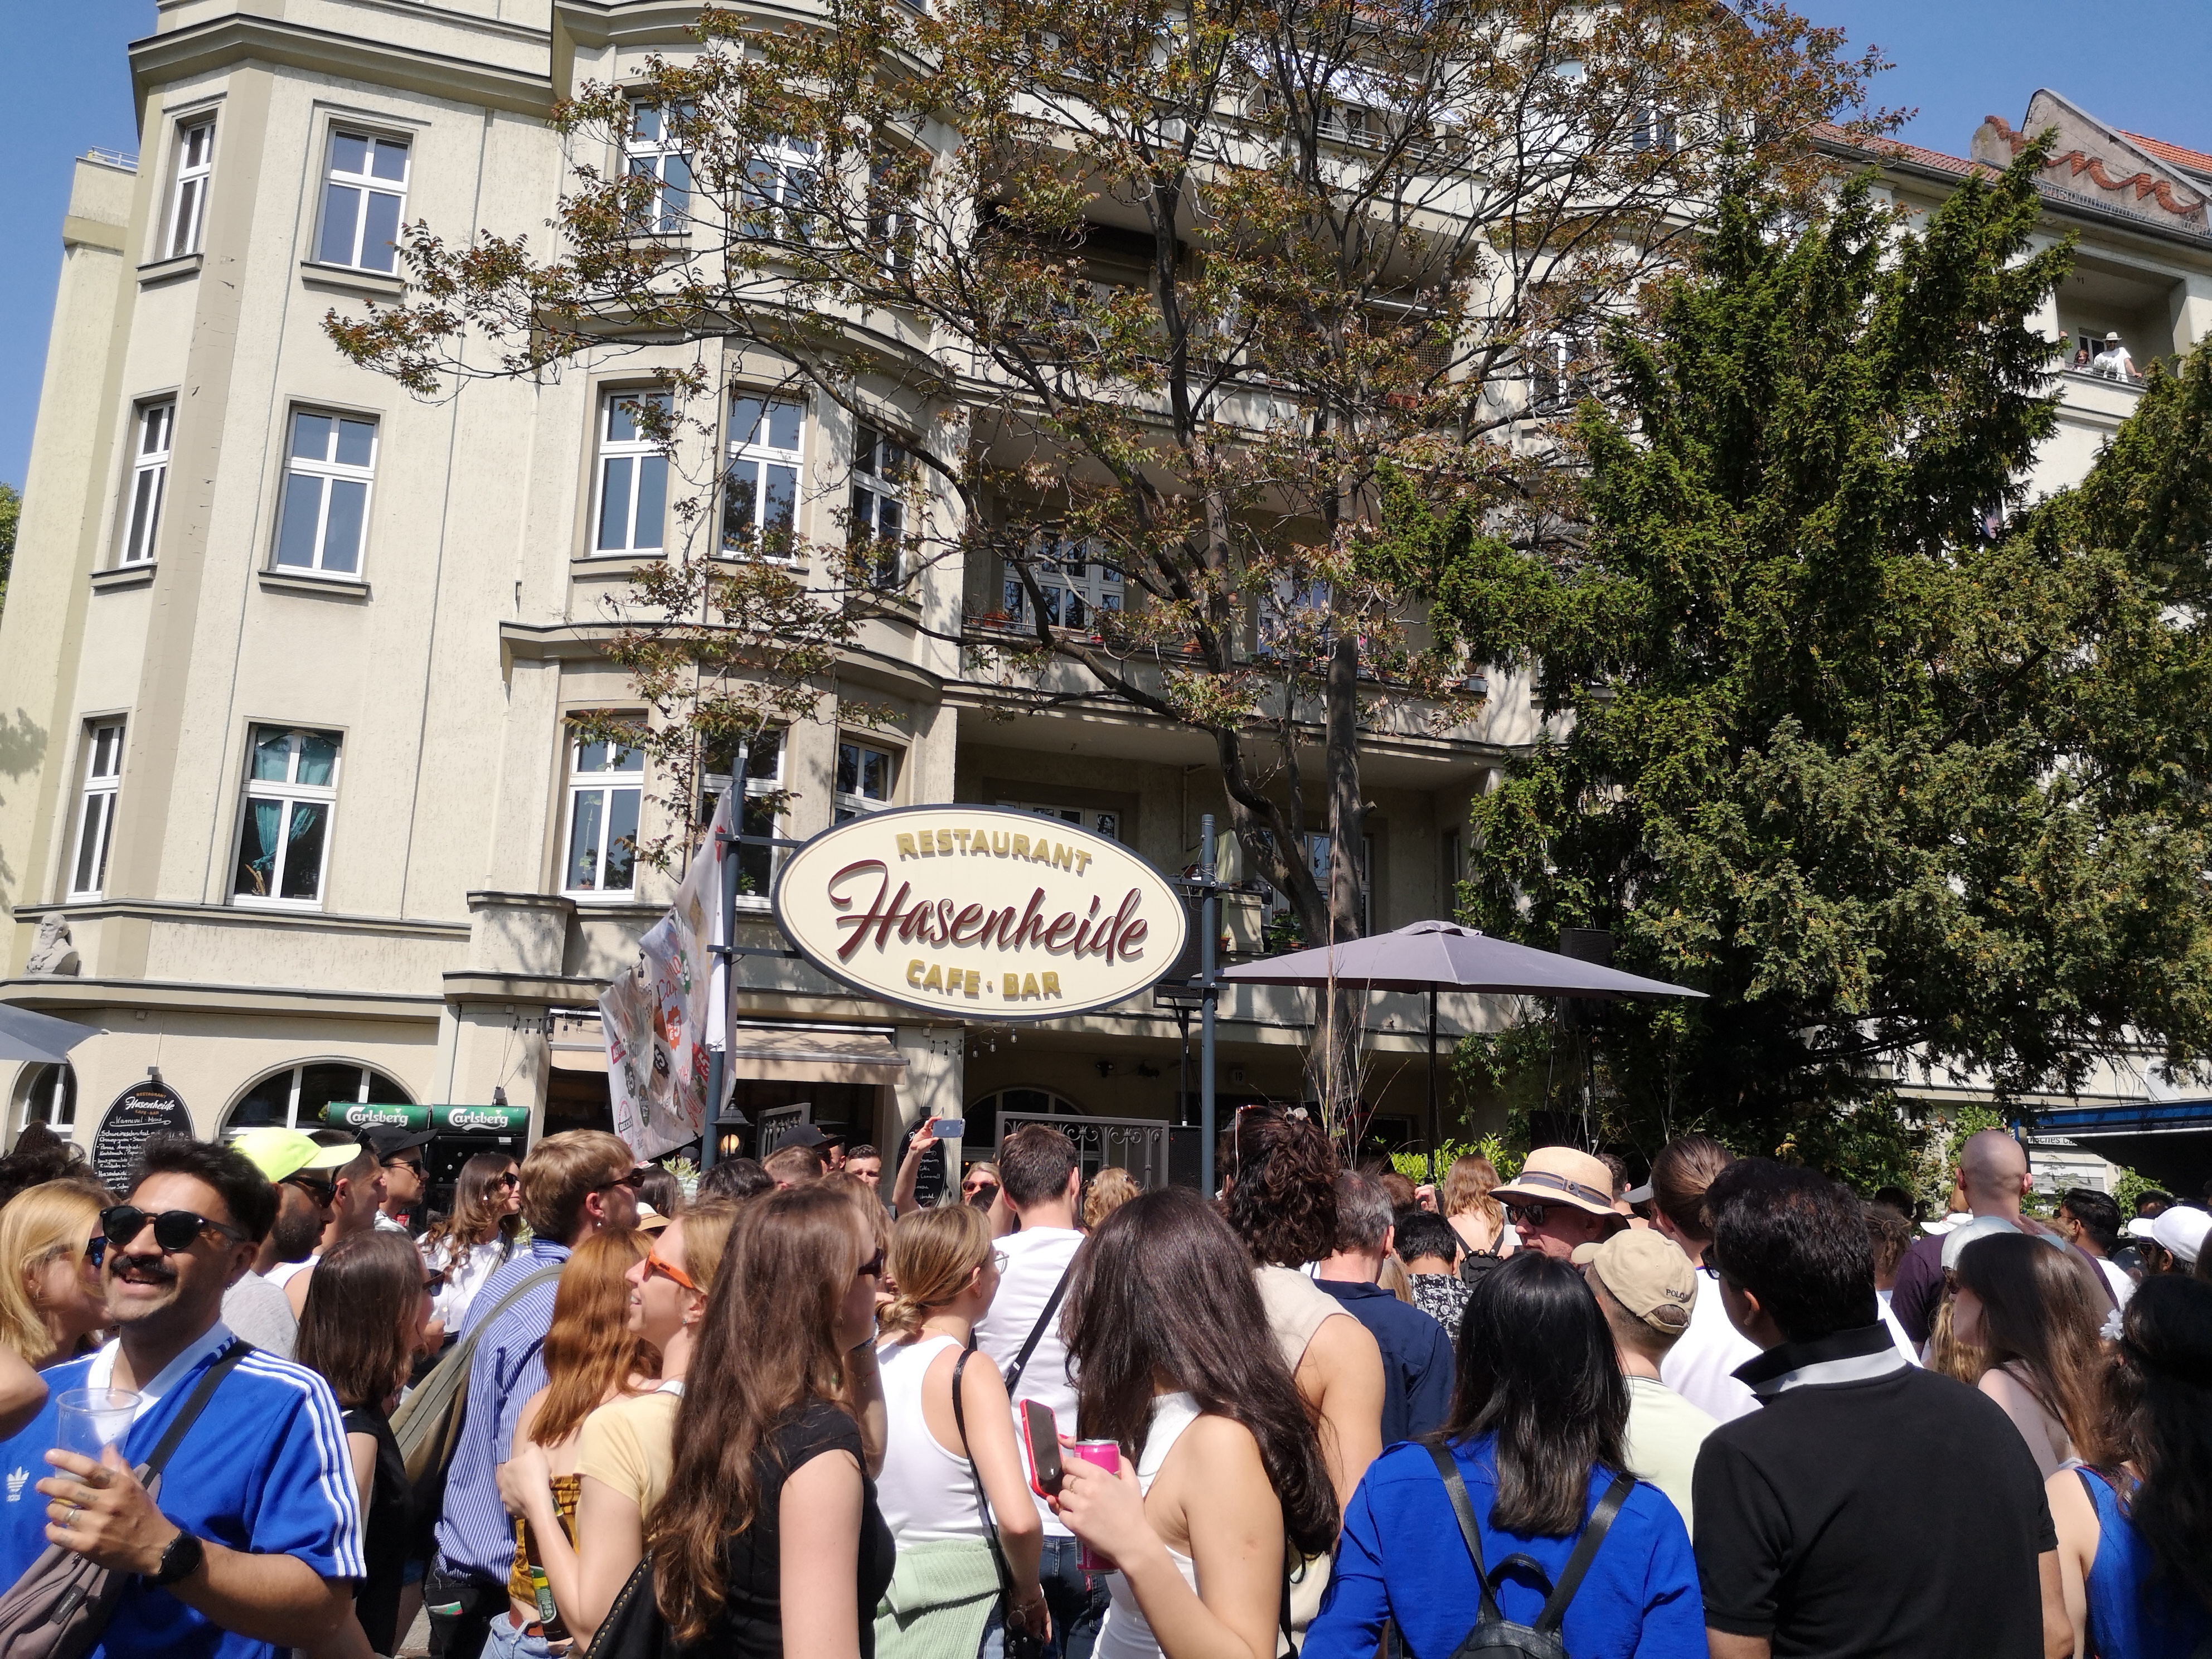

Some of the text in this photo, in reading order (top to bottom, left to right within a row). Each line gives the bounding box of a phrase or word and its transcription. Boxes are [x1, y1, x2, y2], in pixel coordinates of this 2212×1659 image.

[896, 828, 1092, 874] RESTAURANT
[828, 859, 1149, 962] Hasenheide
[905, 959, 1062, 998] CAFE BAR
[1235, 1072, 1243, 1081] 19
[125, 1096, 176, 1111] Hasenheide
[346, 1107, 409, 1128] Carlsberg
[449, 1108, 509, 1128] Carlsberg
[1666, 1288, 1685, 1299] POLO
